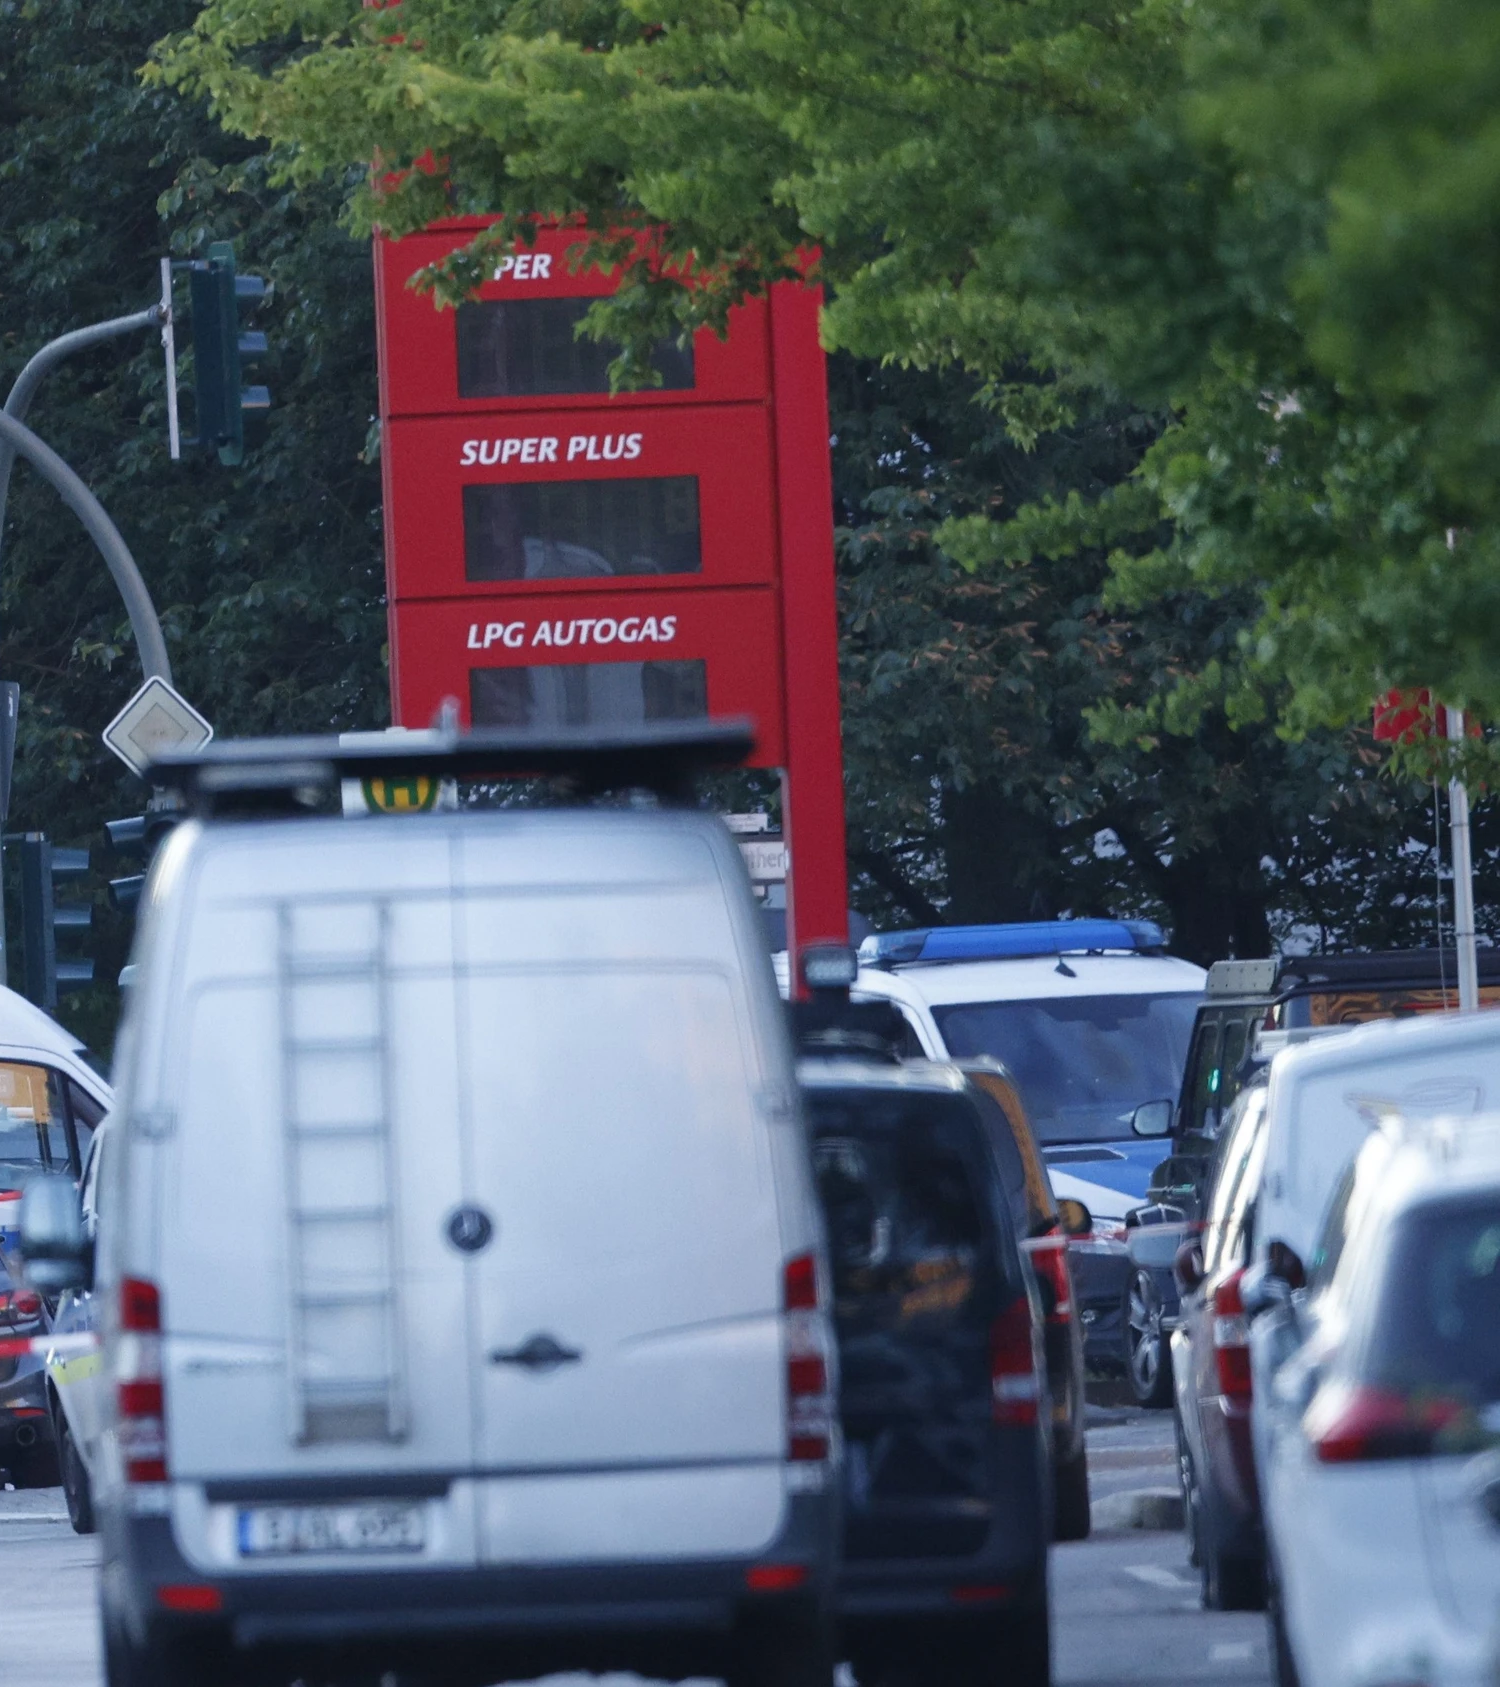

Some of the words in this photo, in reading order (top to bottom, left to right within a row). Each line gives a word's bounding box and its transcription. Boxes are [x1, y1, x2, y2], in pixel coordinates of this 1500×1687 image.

[493, 252, 552, 281] PER
[459, 436, 559, 466] SUPER
[566, 432, 644, 461] PLUS
[466, 621, 526, 649] LPG
[531, 615, 677, 647] AUTOGAS
